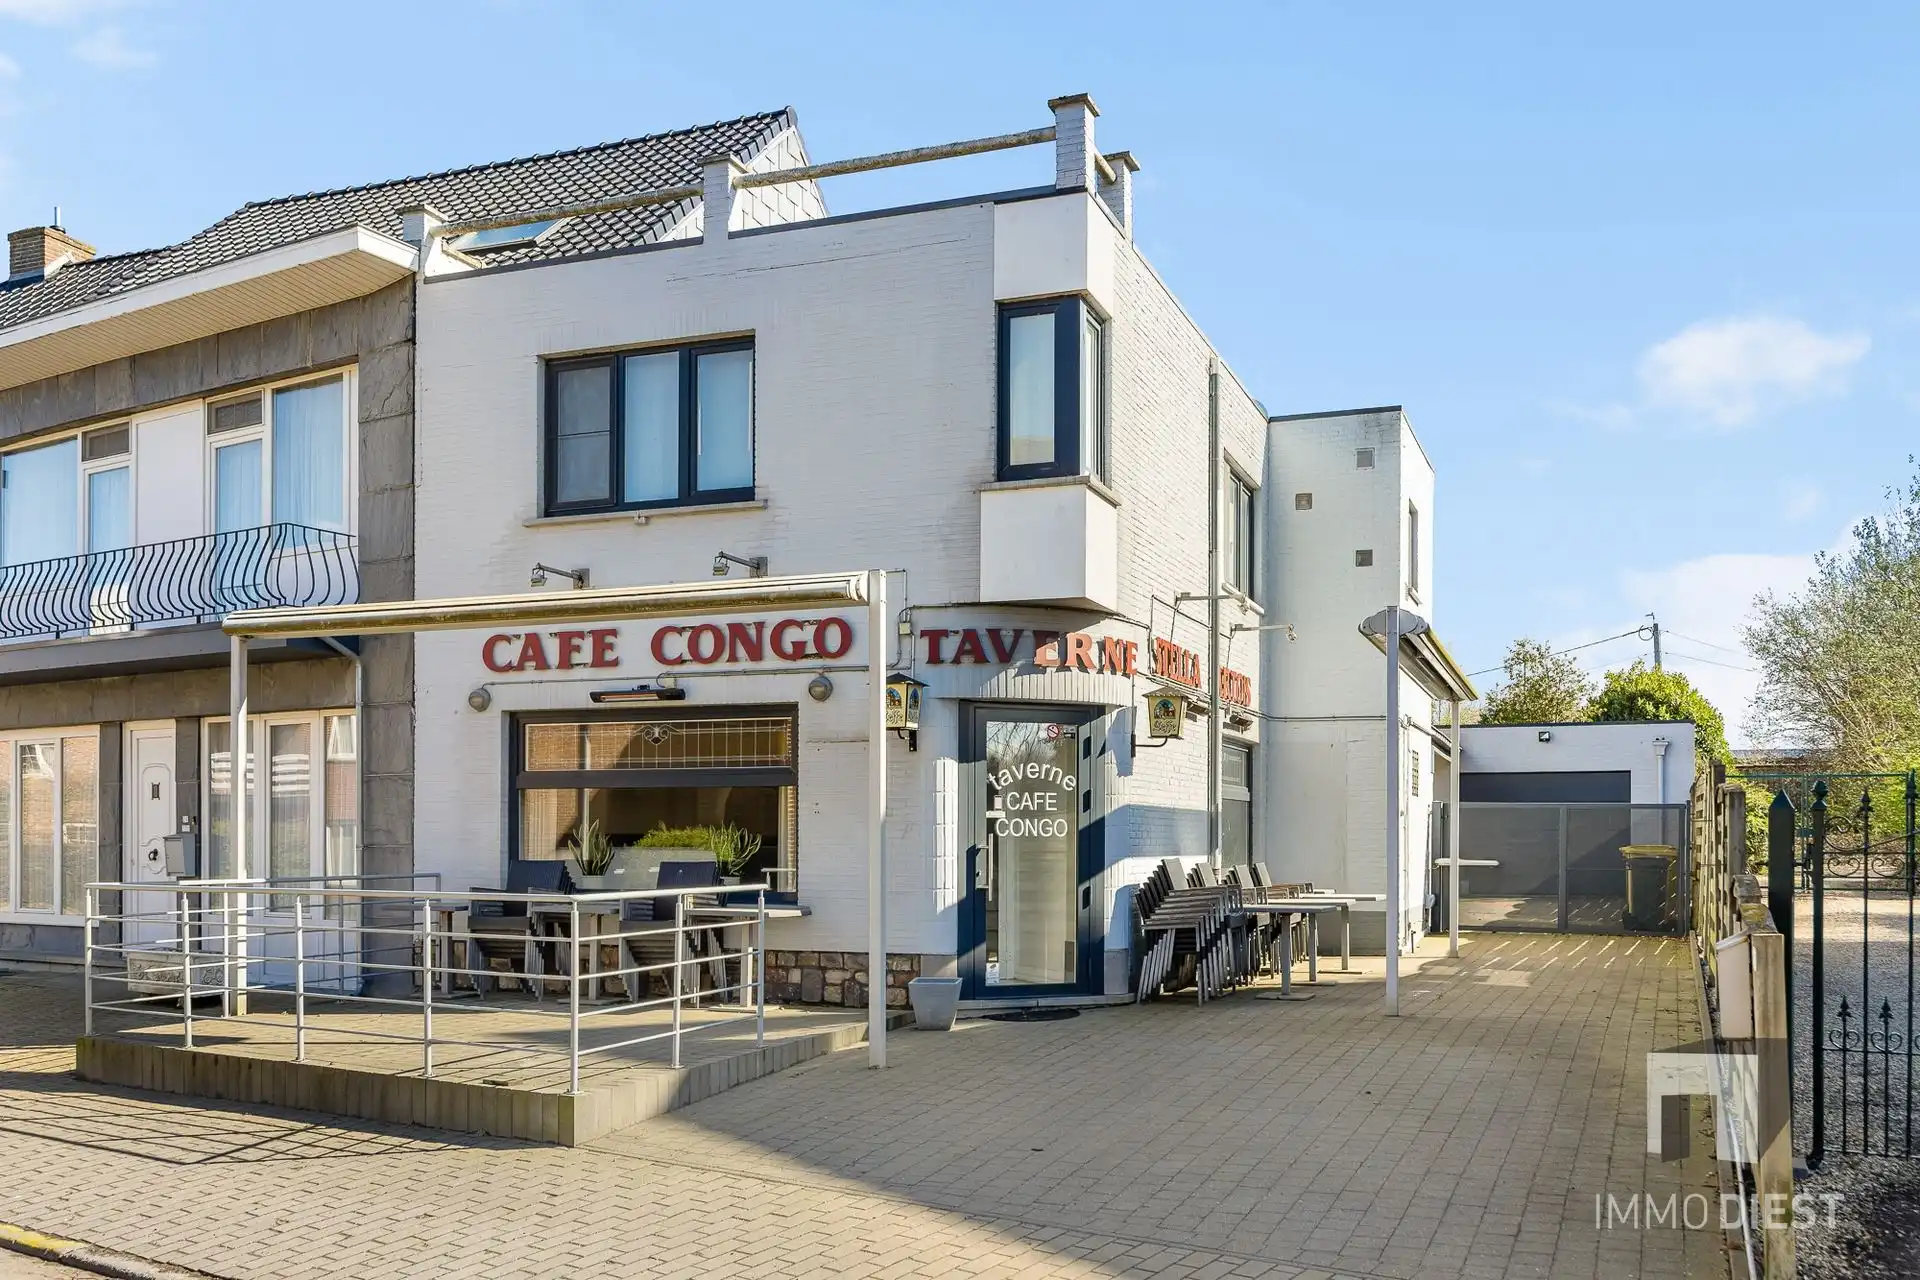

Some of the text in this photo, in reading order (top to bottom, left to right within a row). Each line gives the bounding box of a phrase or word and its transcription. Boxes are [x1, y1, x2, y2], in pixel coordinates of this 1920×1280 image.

[482, 616, 853, 673] CAFE CONGO
[920, 628, 1138, 676] TAVERNE
[1153, 636, 1202, 688] STELLA
[988, 762, 1077, 791] taverne
[1006, 791, 1058, 811] CAFE
[995, 818, 1068, 837] CONGO
